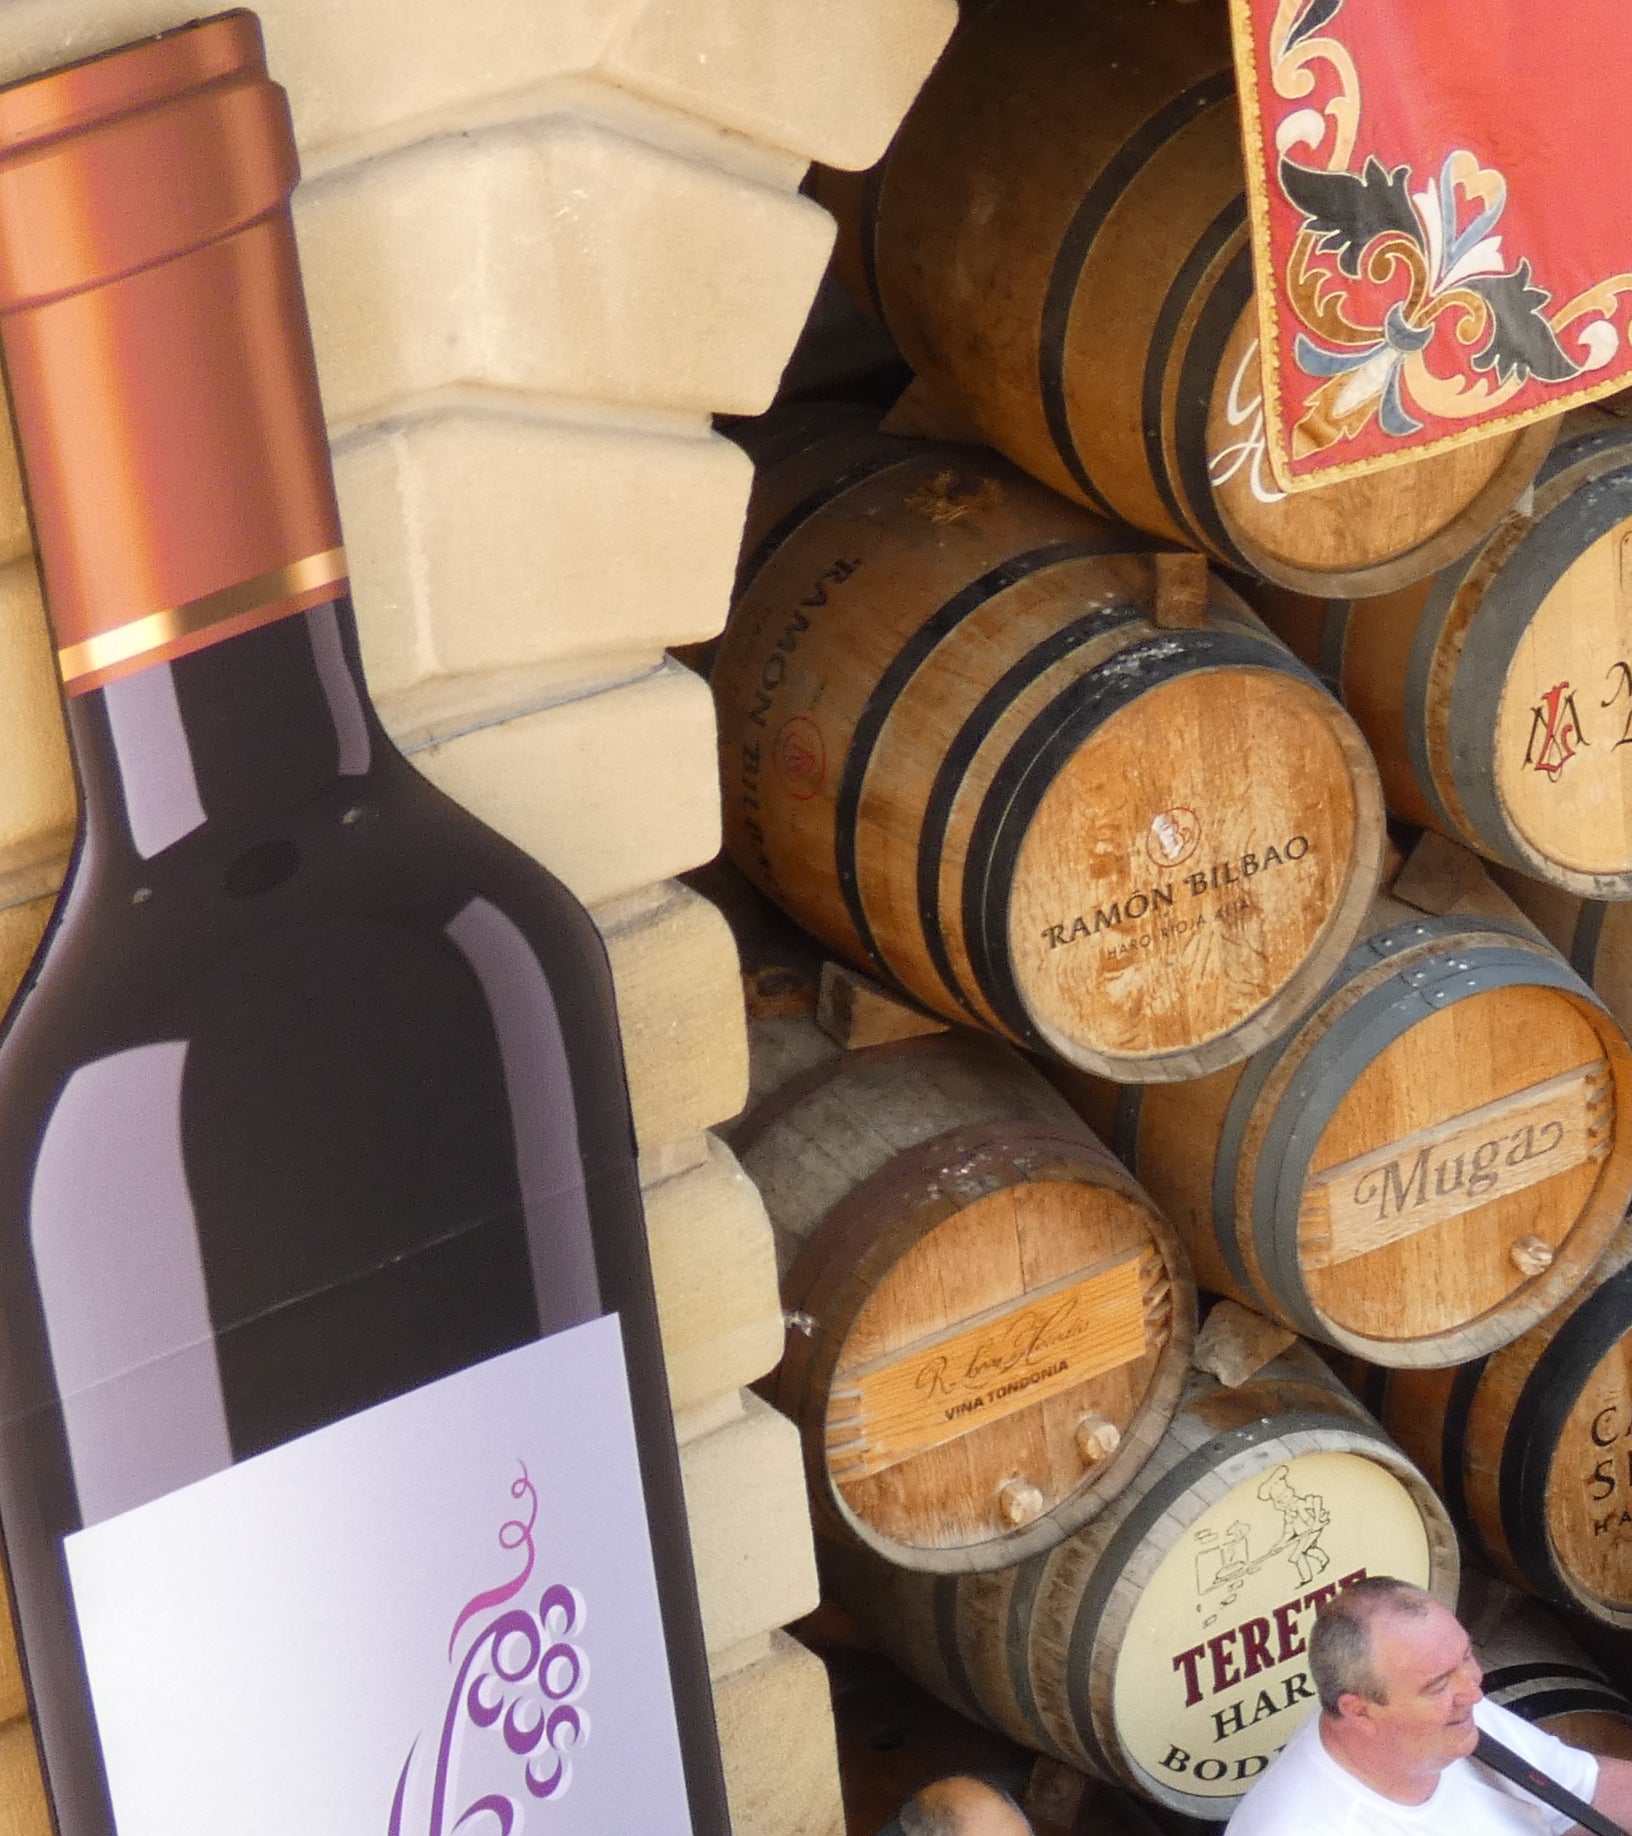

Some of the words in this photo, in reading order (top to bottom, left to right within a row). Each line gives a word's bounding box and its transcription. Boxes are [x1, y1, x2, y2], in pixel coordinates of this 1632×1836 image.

[1040, 882, 1175, 950] RAMÓN
[1183, 835, 1310, 898] BILBAO
[1106, 934, 1152, 960] HARO
[1161, 914, 1207, 940] RIOJA
[1353, 1120, 1565, 1221] Muga
[987, 1360, 1069, 1402] TONDONIA
[1210, 1672, 1316, 1743] HAR
